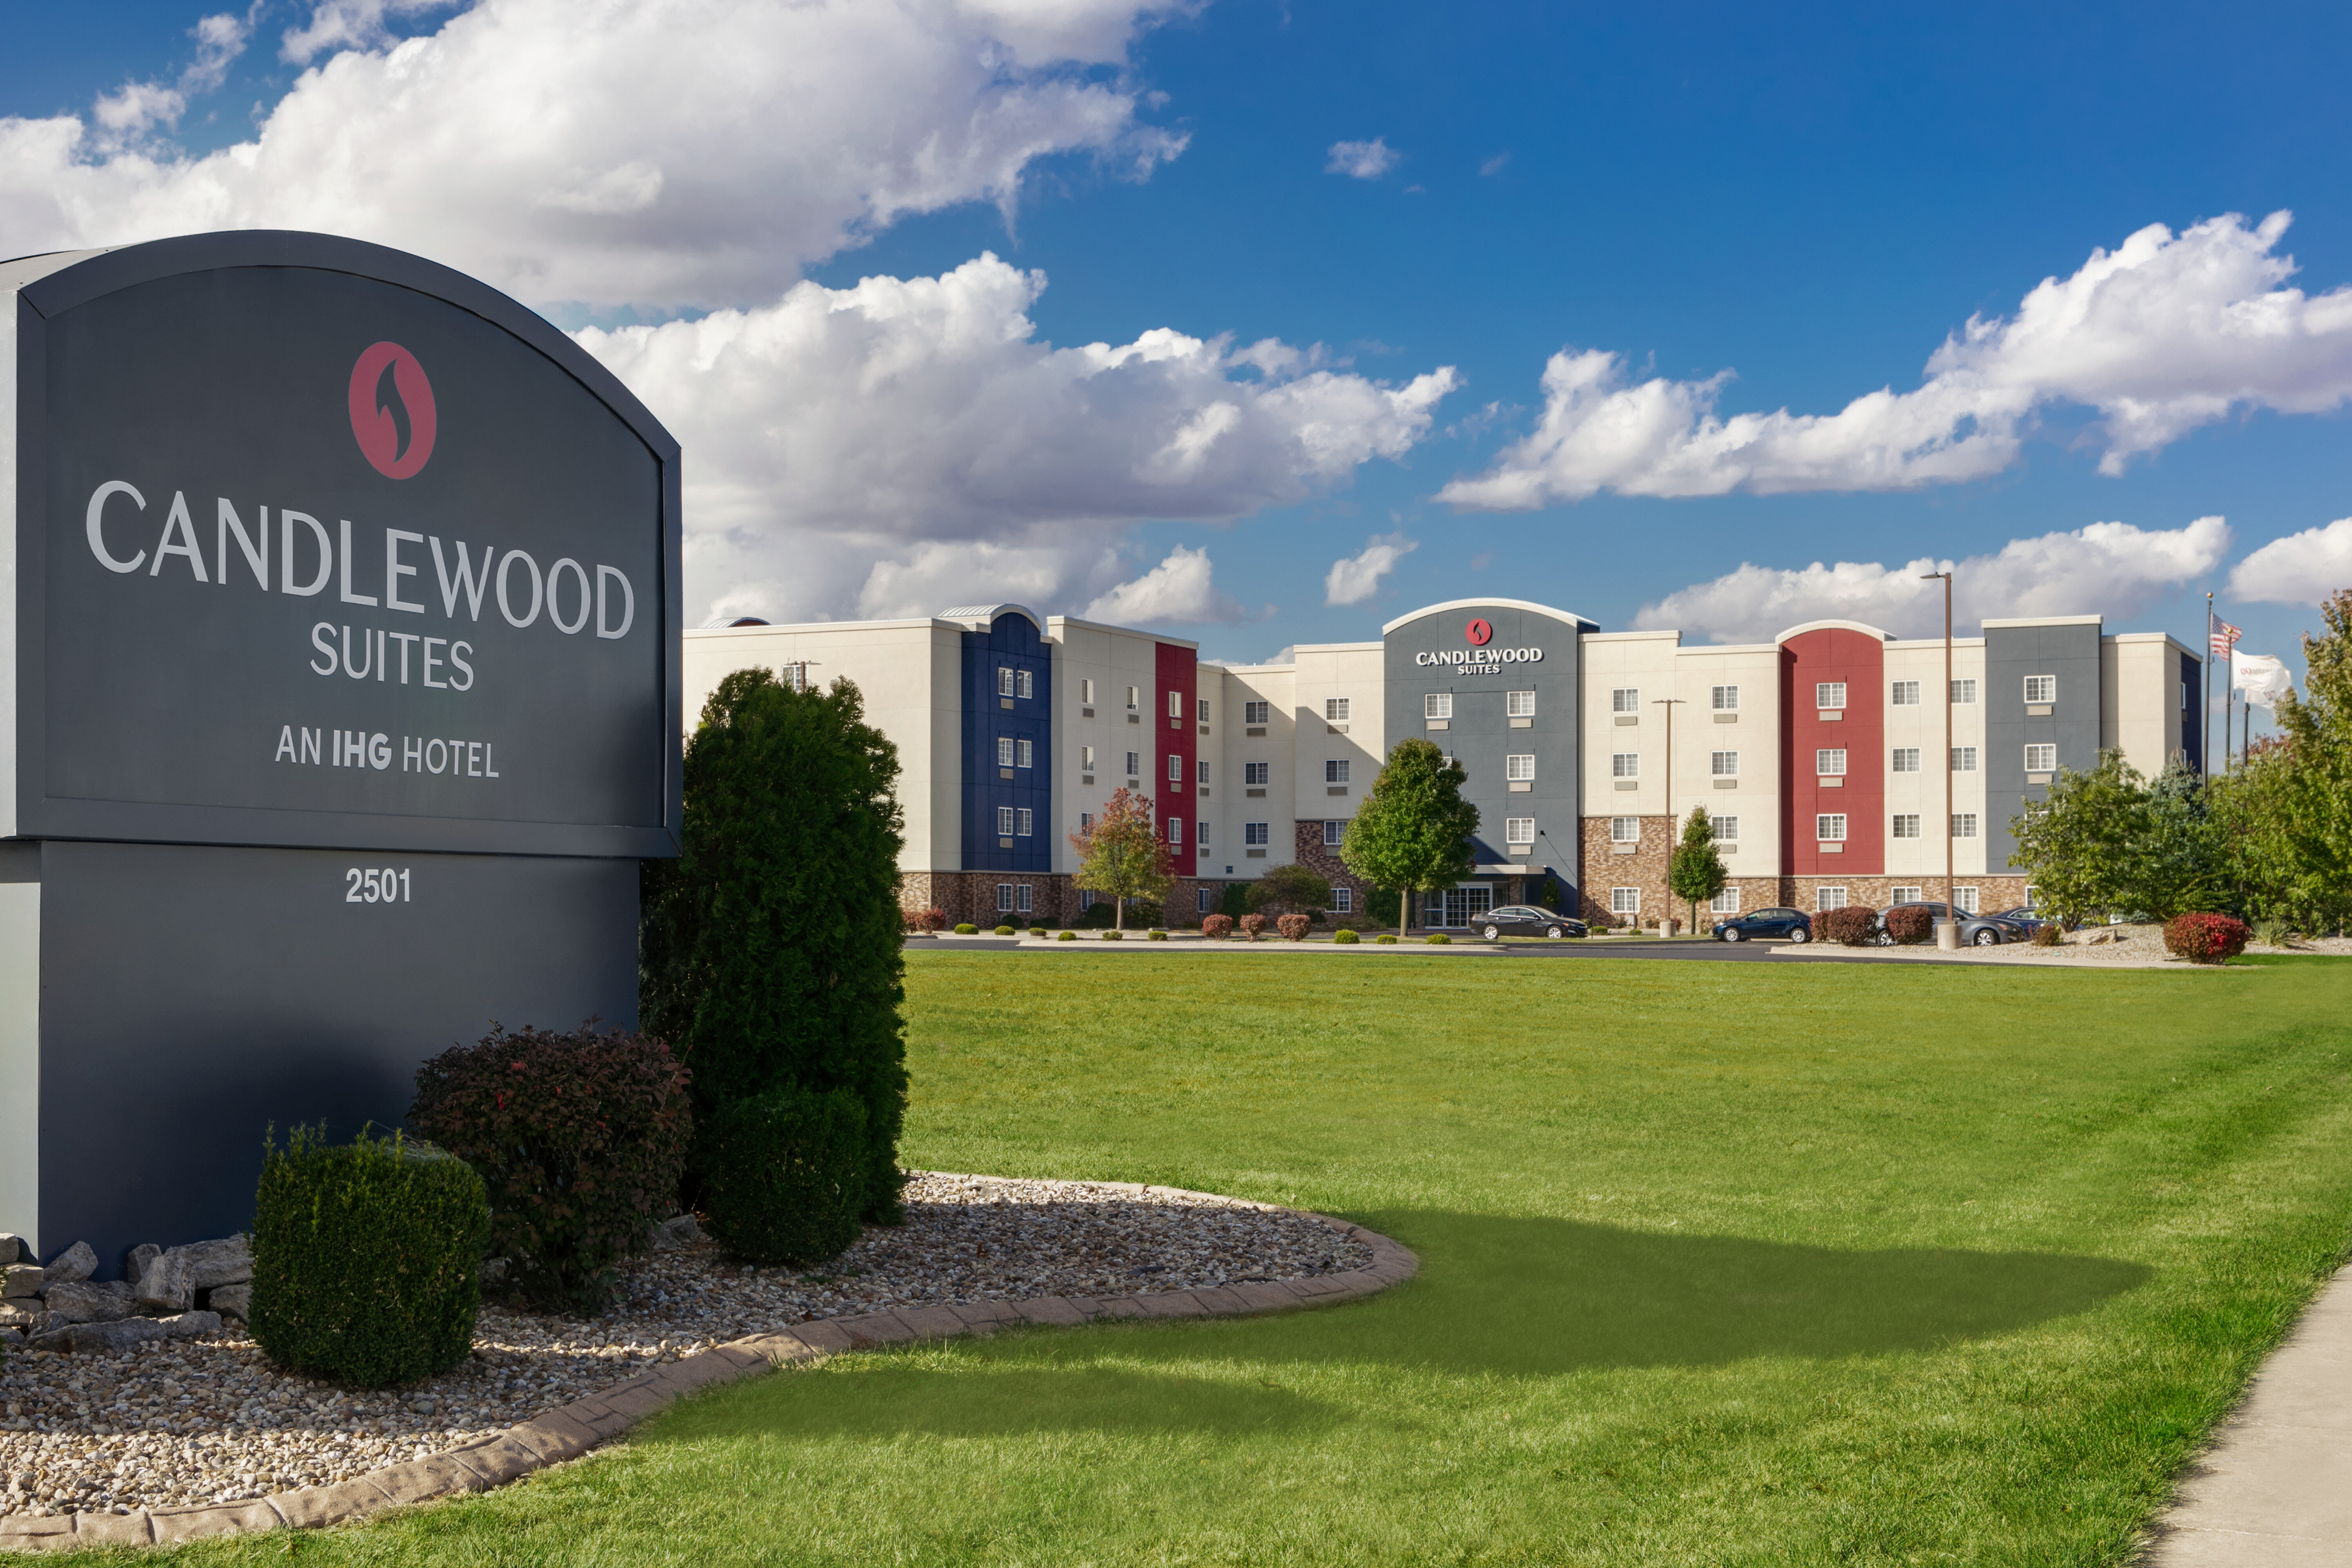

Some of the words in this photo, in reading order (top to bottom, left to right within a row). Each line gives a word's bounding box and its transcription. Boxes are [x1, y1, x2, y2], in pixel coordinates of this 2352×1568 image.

[86, 480, 635, 640] CANDLEWOOD
[310, 621, 474, 691] SUITES
[1415, 648, 1543, 666] CANDLEWOOD
[1457, 664, 1500, 675] SUITES
[274, 724, 321, 766] AN
[332, 729, 392, 770] IHG
[403, 735, 499, 778] HOTEL
[345, 867, 410, 904] 2501
